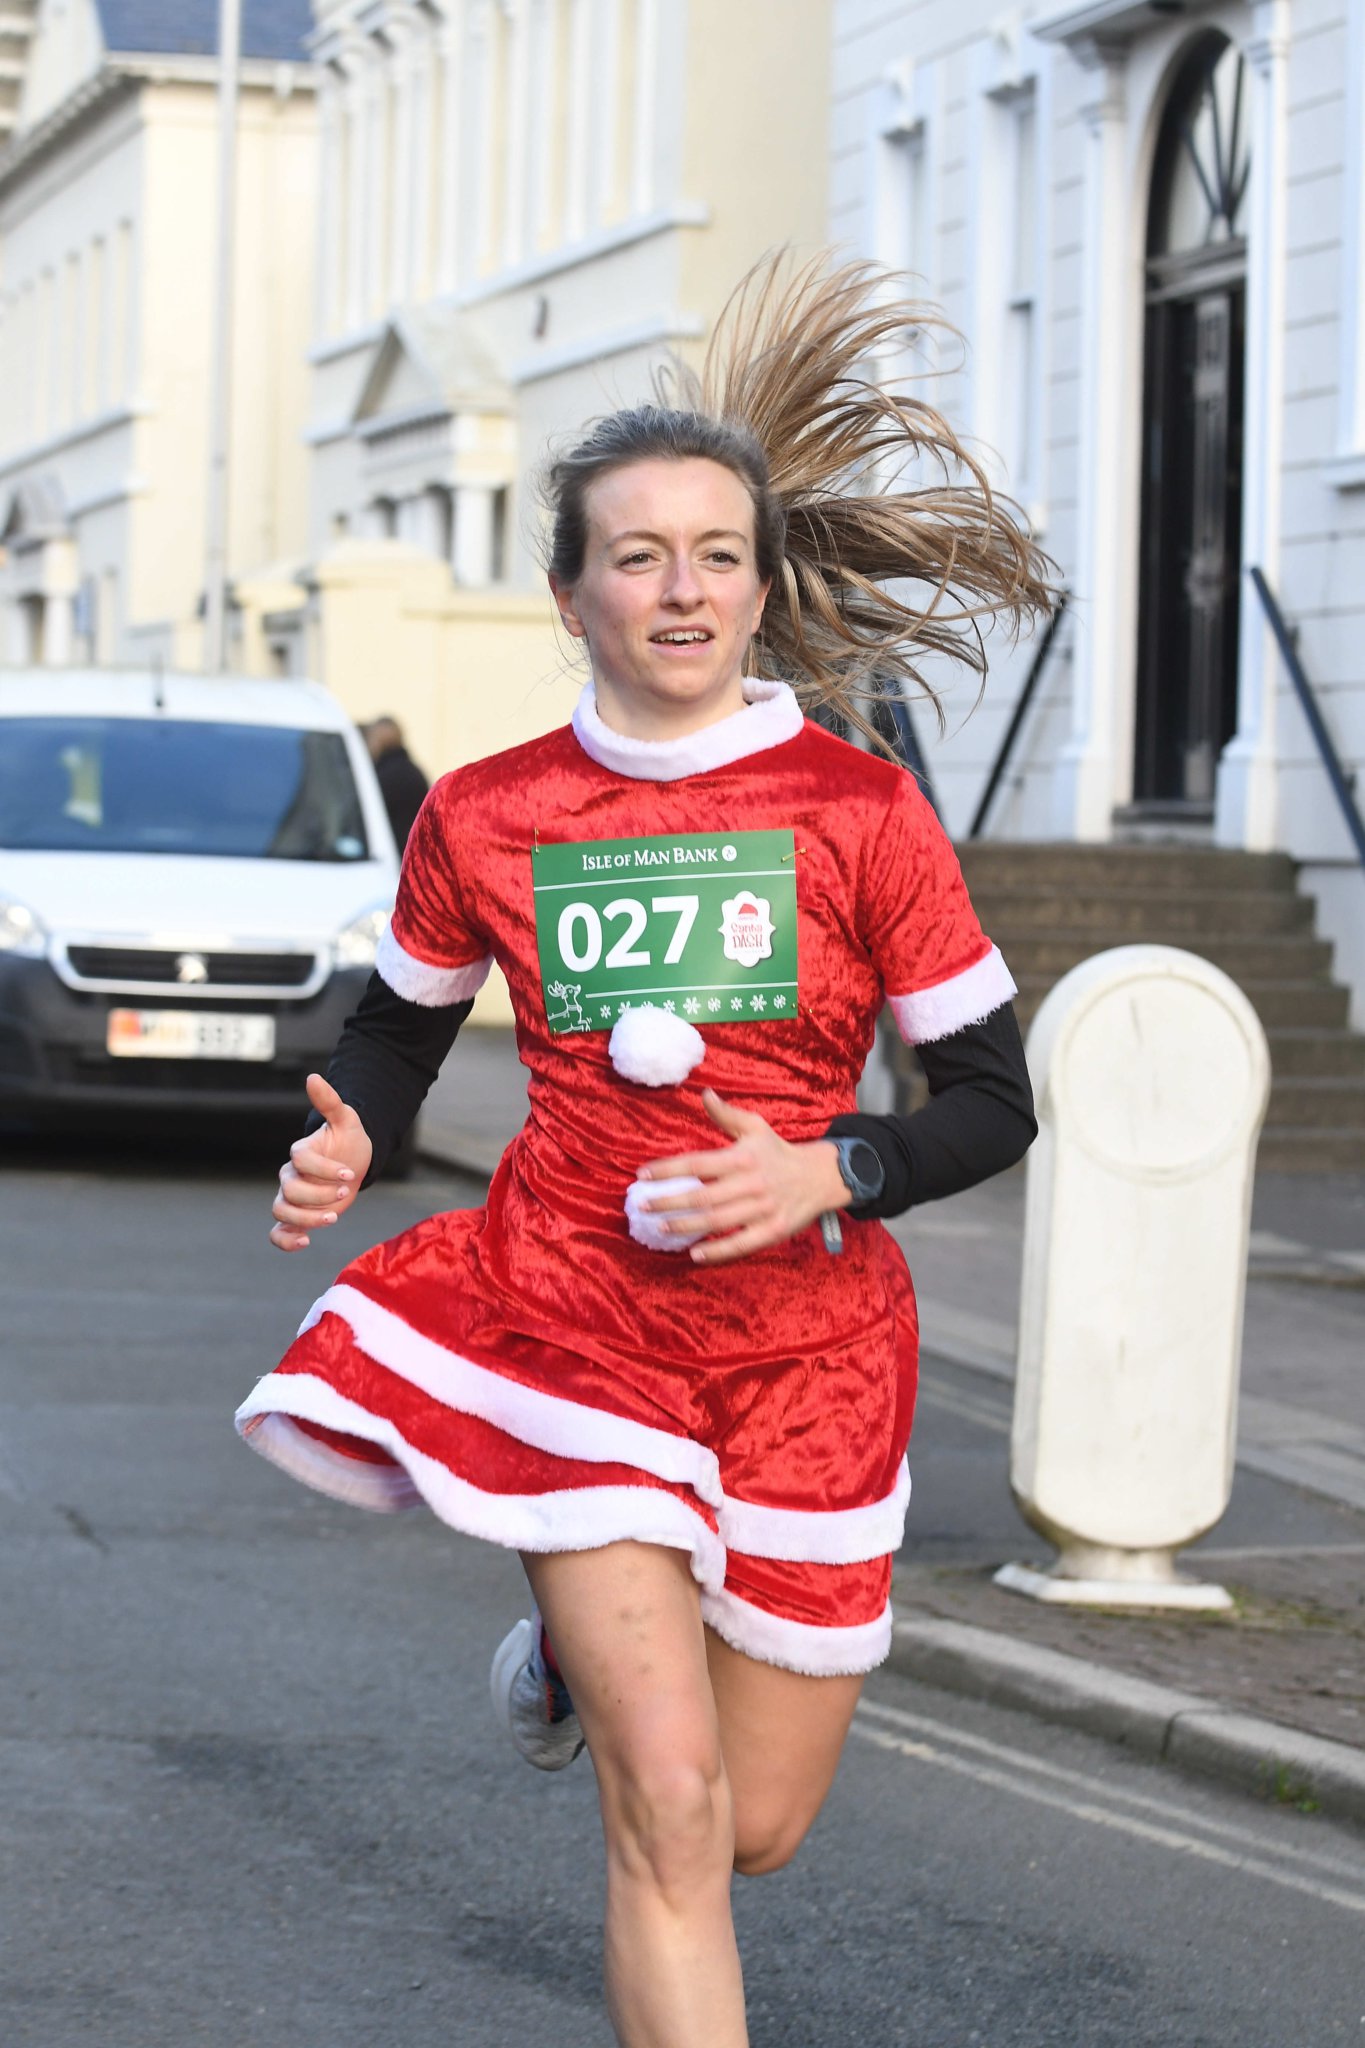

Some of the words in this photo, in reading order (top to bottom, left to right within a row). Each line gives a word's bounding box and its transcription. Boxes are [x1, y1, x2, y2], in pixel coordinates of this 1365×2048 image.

[582, 854, 612, 871] ISLE
[614, 854, 631, 867] OF
[634, 849, 670, 866] MAN
[673, 847, 718, 864] BANK
[557, 895, 699, 972] 027
